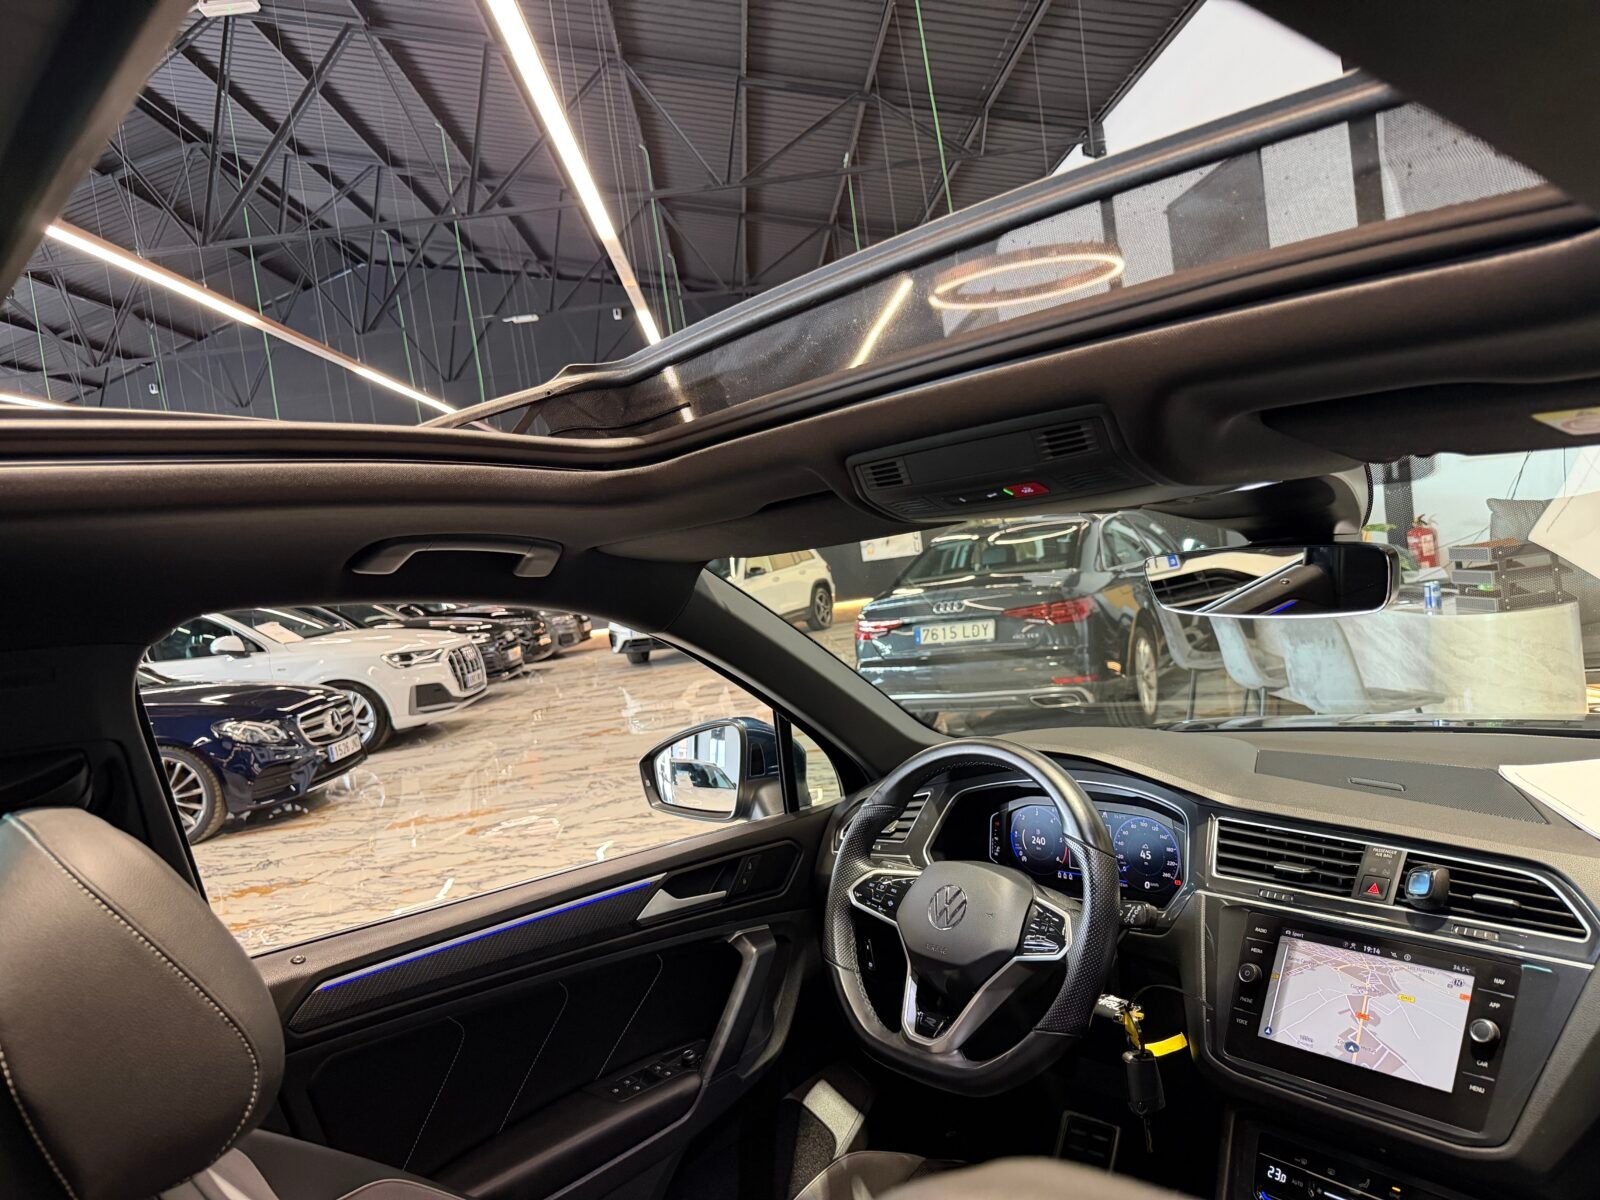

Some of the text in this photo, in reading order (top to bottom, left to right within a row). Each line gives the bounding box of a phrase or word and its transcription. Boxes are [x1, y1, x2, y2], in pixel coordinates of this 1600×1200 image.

[922, 624, 989, 641] 7615 LDY
[1031, 836, 1046, 846] 240
[1140, 850, 1151, 860] 45
[1236, 1018, 1249, 1026] VOICE
[1476, 1060, 1488, 1068] CAR
[1469, 1084, 1485, 1094] MENU
